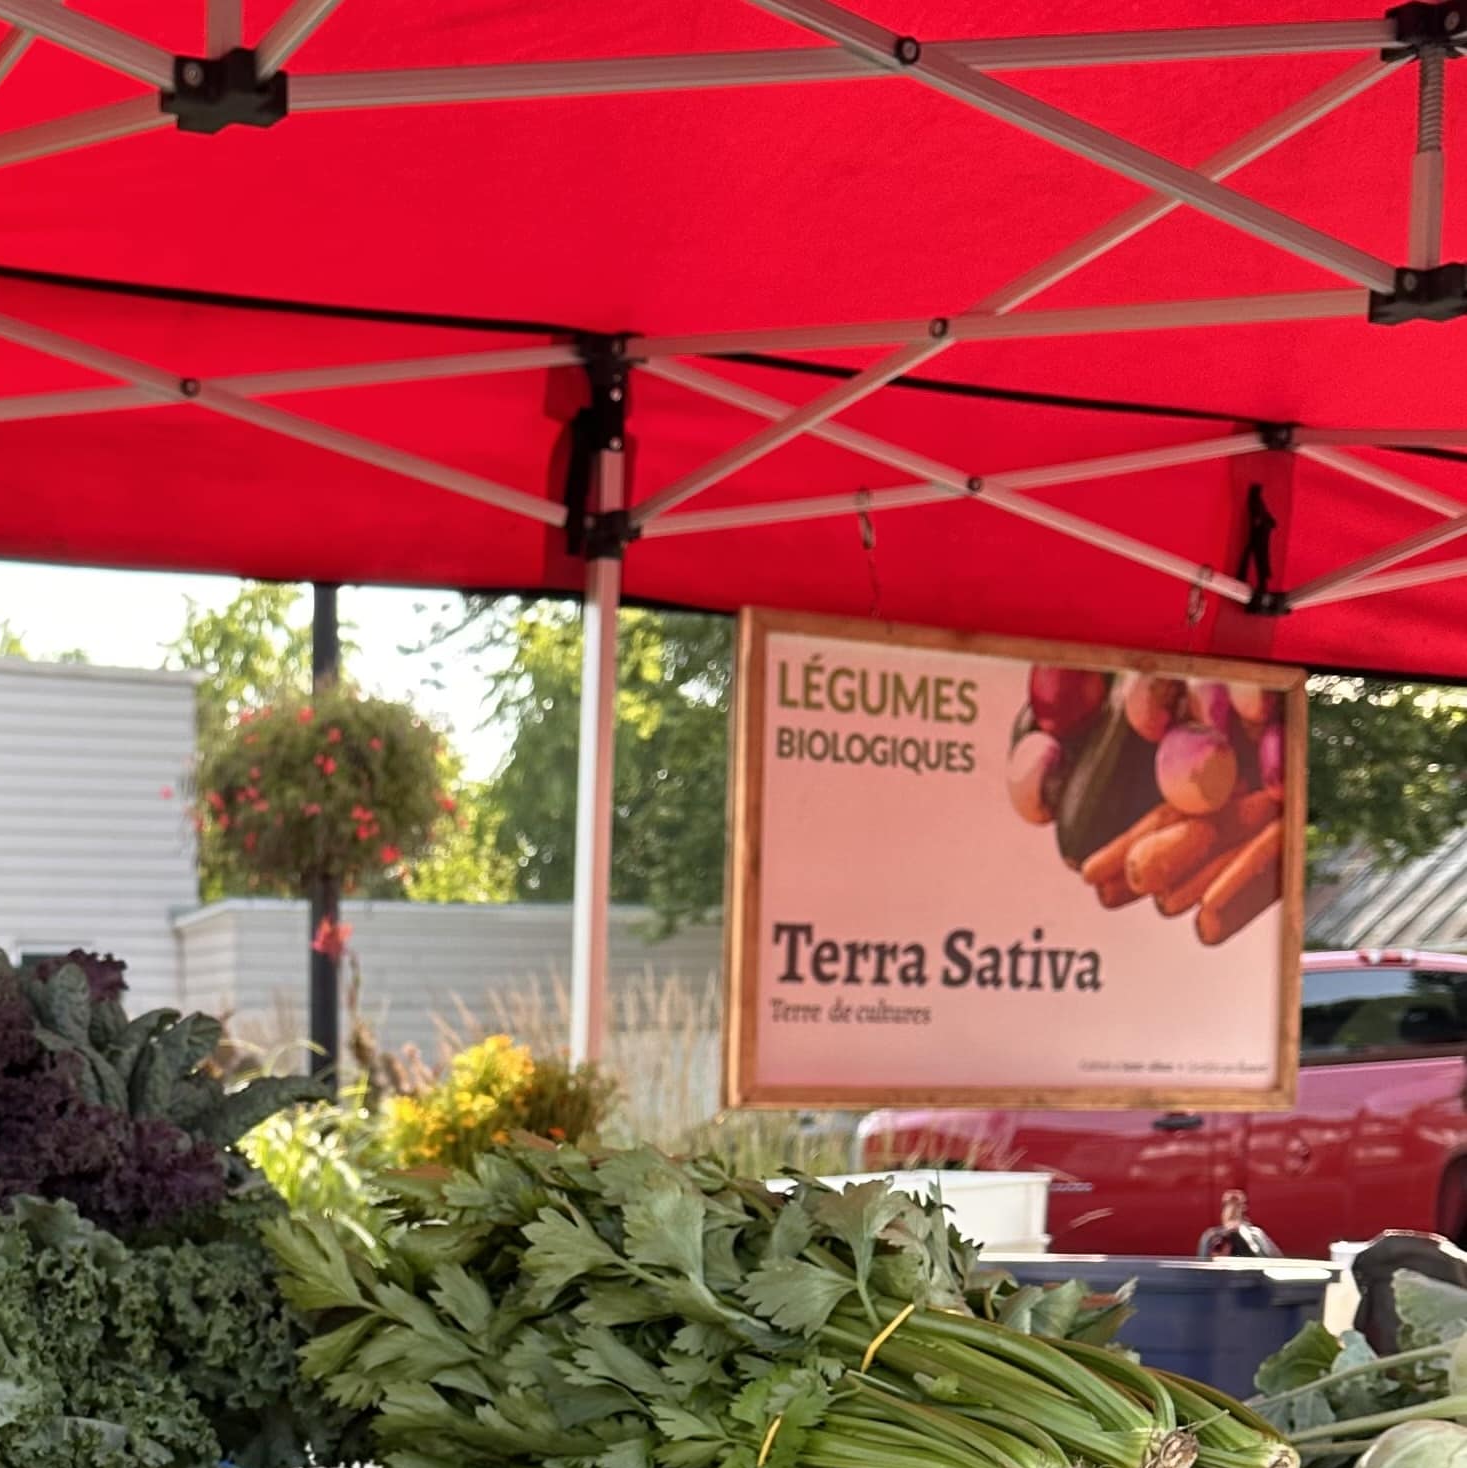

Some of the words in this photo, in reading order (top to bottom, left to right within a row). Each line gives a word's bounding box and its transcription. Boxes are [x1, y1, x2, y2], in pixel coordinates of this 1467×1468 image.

[776, 654, 979, 725] LÉGUMES
[775, 726, 976, 774] BIOLOGIQUES
[772, 921, 928, 987] Terra
[940, 927, 1102, 992] Sativa
[770, 997, 822, 1023] Terre
[828, 996, 852, 1023] de
[855, 998, 932, 1025] cultures
